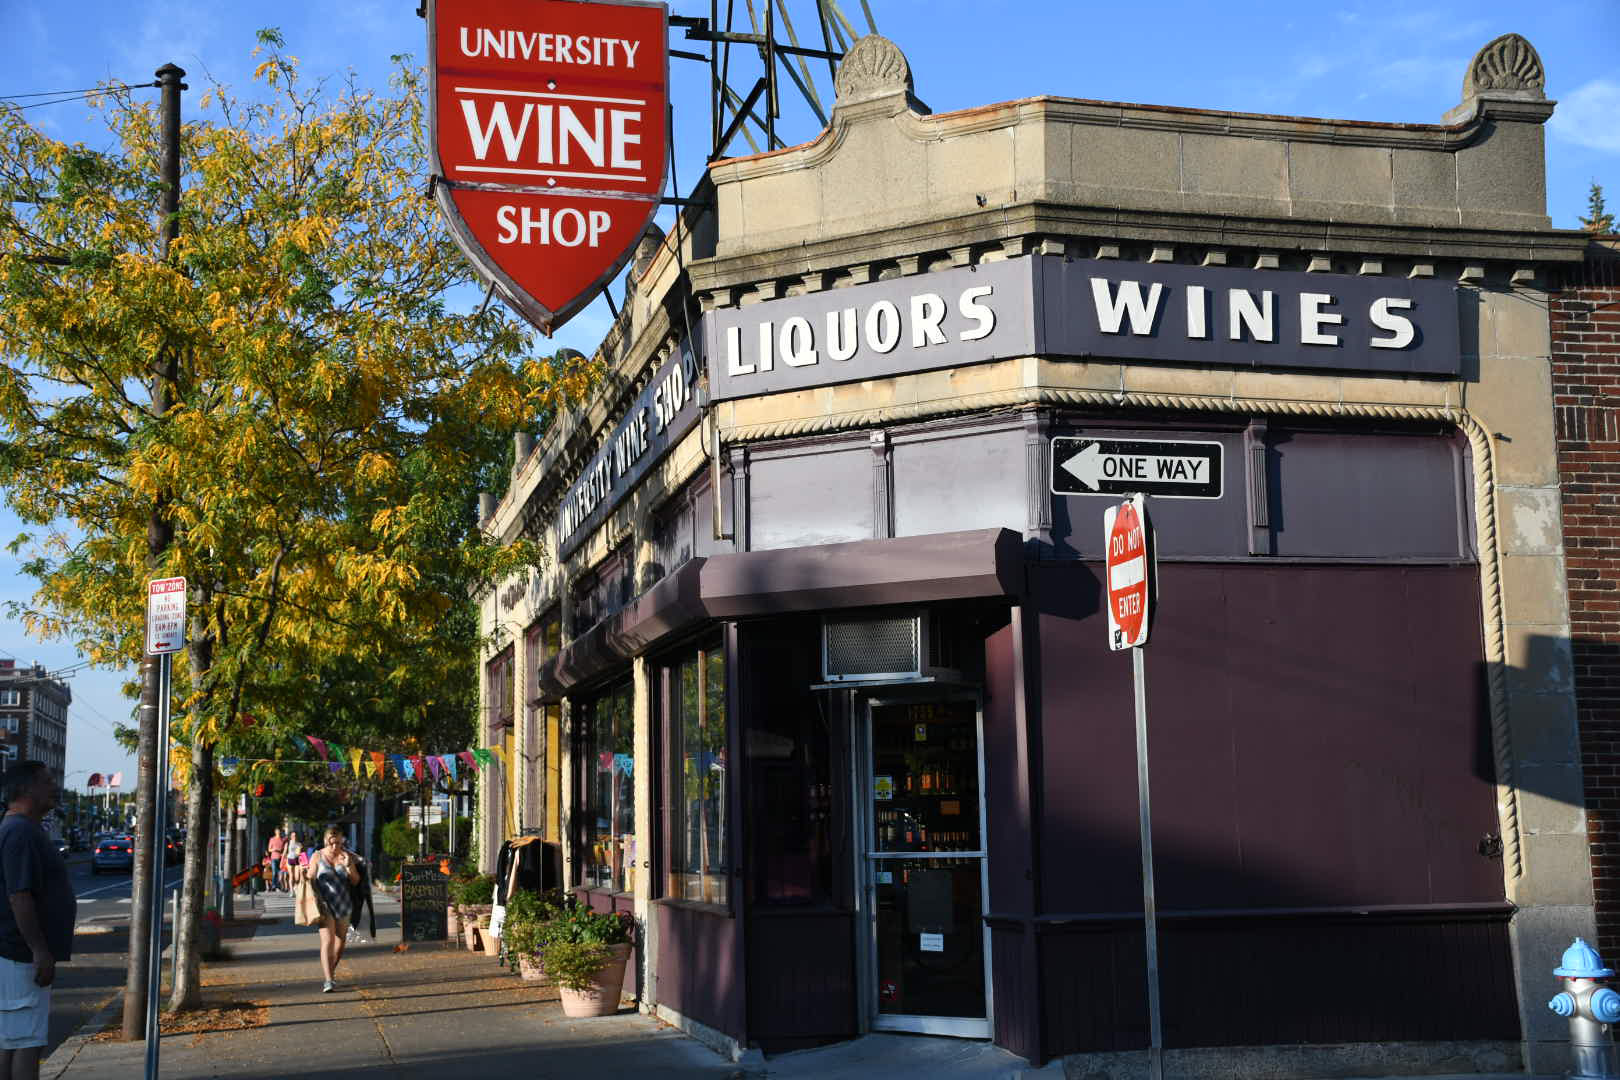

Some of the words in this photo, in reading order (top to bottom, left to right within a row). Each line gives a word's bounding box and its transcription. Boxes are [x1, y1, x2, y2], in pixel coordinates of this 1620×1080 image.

[459, 26, 641, 69] UNIVERSITY
[460, 98, 642, 170] WINE
[496, 204, 612, 248] SHOP
[726, 285, 997, 377] LIQUORS
[1090, 277, 1416, 349] WINES
[560, 451, 614, 545] UNIVERSITY
[615, 406, 649, 479] WINE
[653, 350, 695, 436] SHOP
[1102, 456, 1148, 479] ONE
[1156, 458, 1203, 480] WAY
[1113, 533, 1124, 557] DO
[1127, 526, 1141, 552] NOT
[151, 583, 166, 593] TOW
[167, 581, 184, 592] ZONE
[1118, 591, 1141, 619] ENTER
